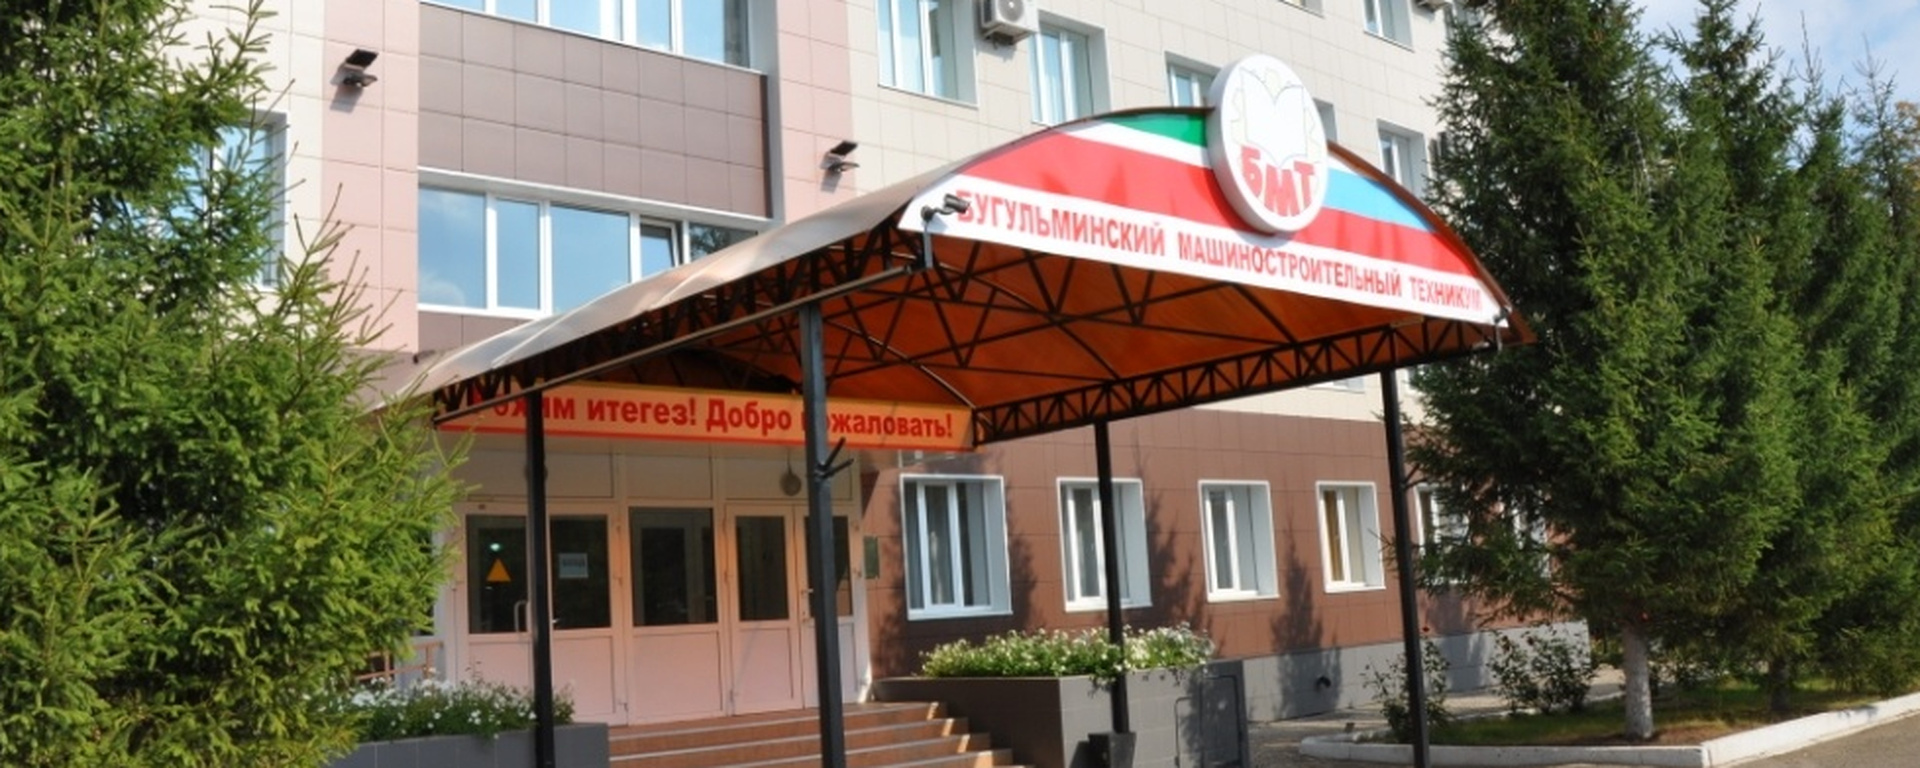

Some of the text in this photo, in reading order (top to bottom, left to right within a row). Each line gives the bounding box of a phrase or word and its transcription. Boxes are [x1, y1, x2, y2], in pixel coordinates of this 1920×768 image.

[1241, 145, 1316, 217] БМТ
[956, 190, 1482, 311] БУГУЛЬМИНСКИЙ МАШИНОСТРОИТЕЛЬНЫЙ ТЕХНИКУМ
[587, 397, 696, 426] итегез!
[706, 398, 792, 435] Добро
[802, 411, 952, 438] жаловать!
